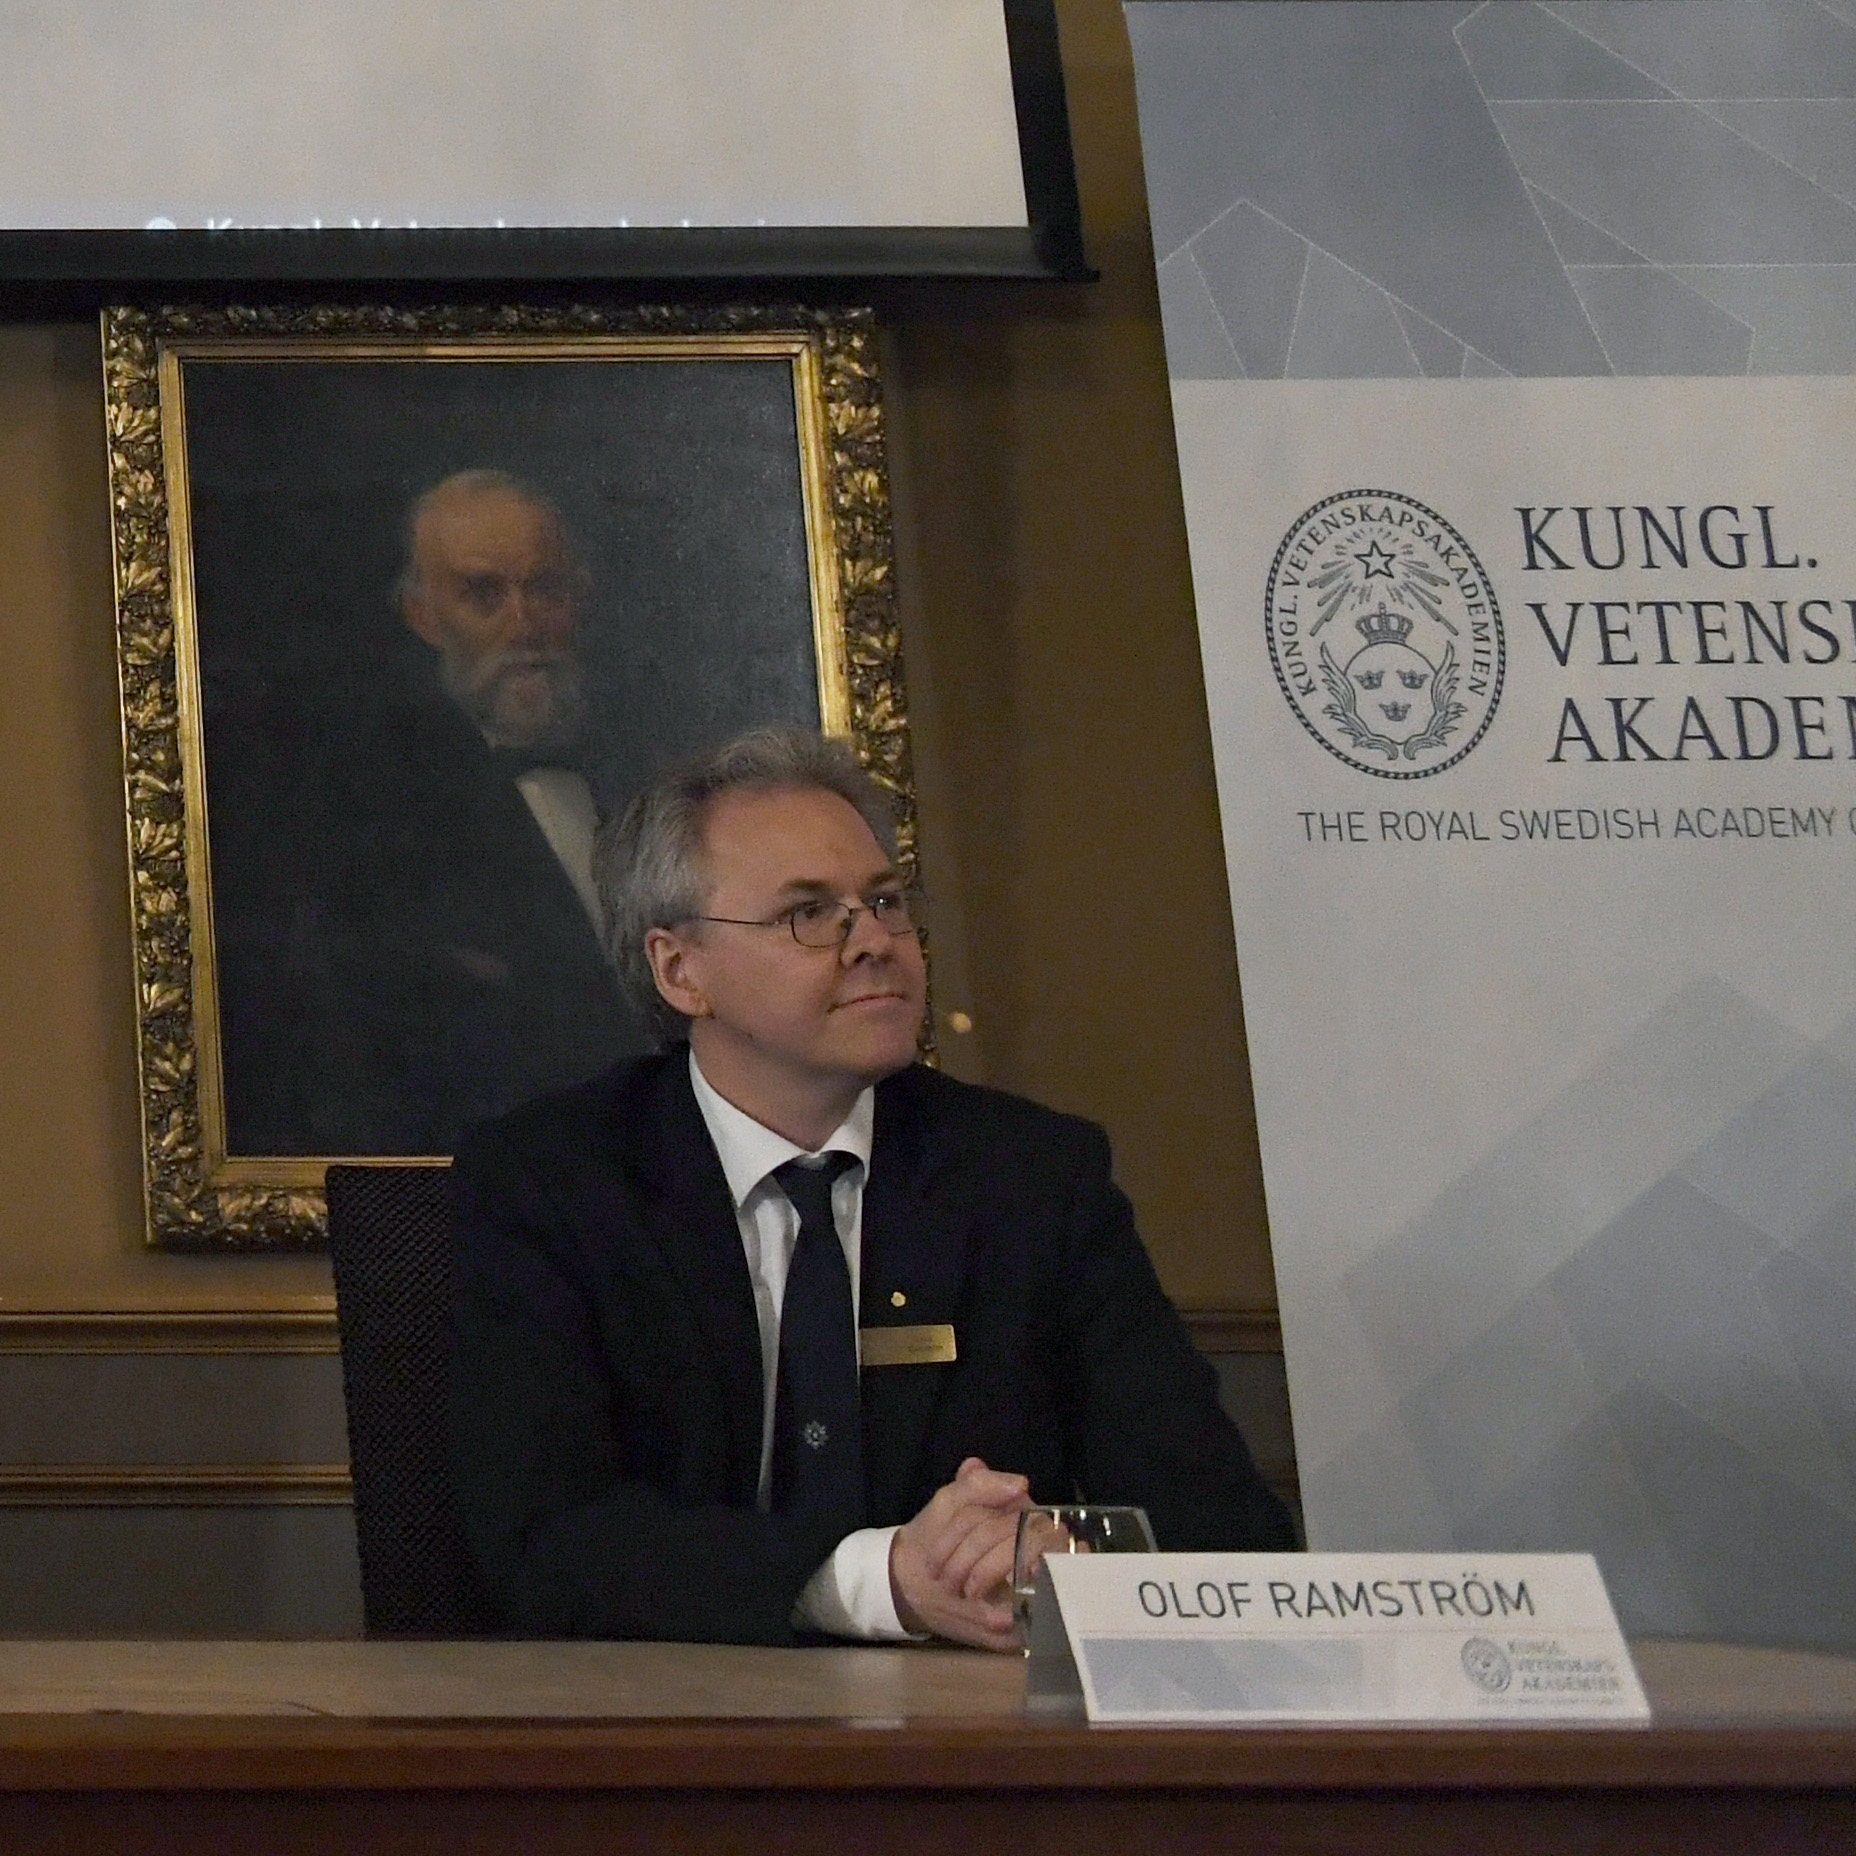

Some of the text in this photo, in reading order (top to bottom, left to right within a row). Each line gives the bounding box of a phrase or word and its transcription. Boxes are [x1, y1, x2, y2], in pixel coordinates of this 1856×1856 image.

[1513, 504, 1819, 571] KUNGL.
[1281, 502, 1492, 698] VETENSKAPSAKADEMIEN
[1524, 599, 1856, 667] VETENS
[1279, 594, 1317, 697] KUNGL.
[1546, 695, 1856, 763] AKADE
[1296, 810, 1369, 843] THE
[1378, 810, 1491, 842] ROYAL
[1499, 808, 1661, 841] SWEDISH
[1673, 806, 1836, 839] ACADEMY
[1137, 1570, 1535, 1619] OLOF RAMSTRÖM
